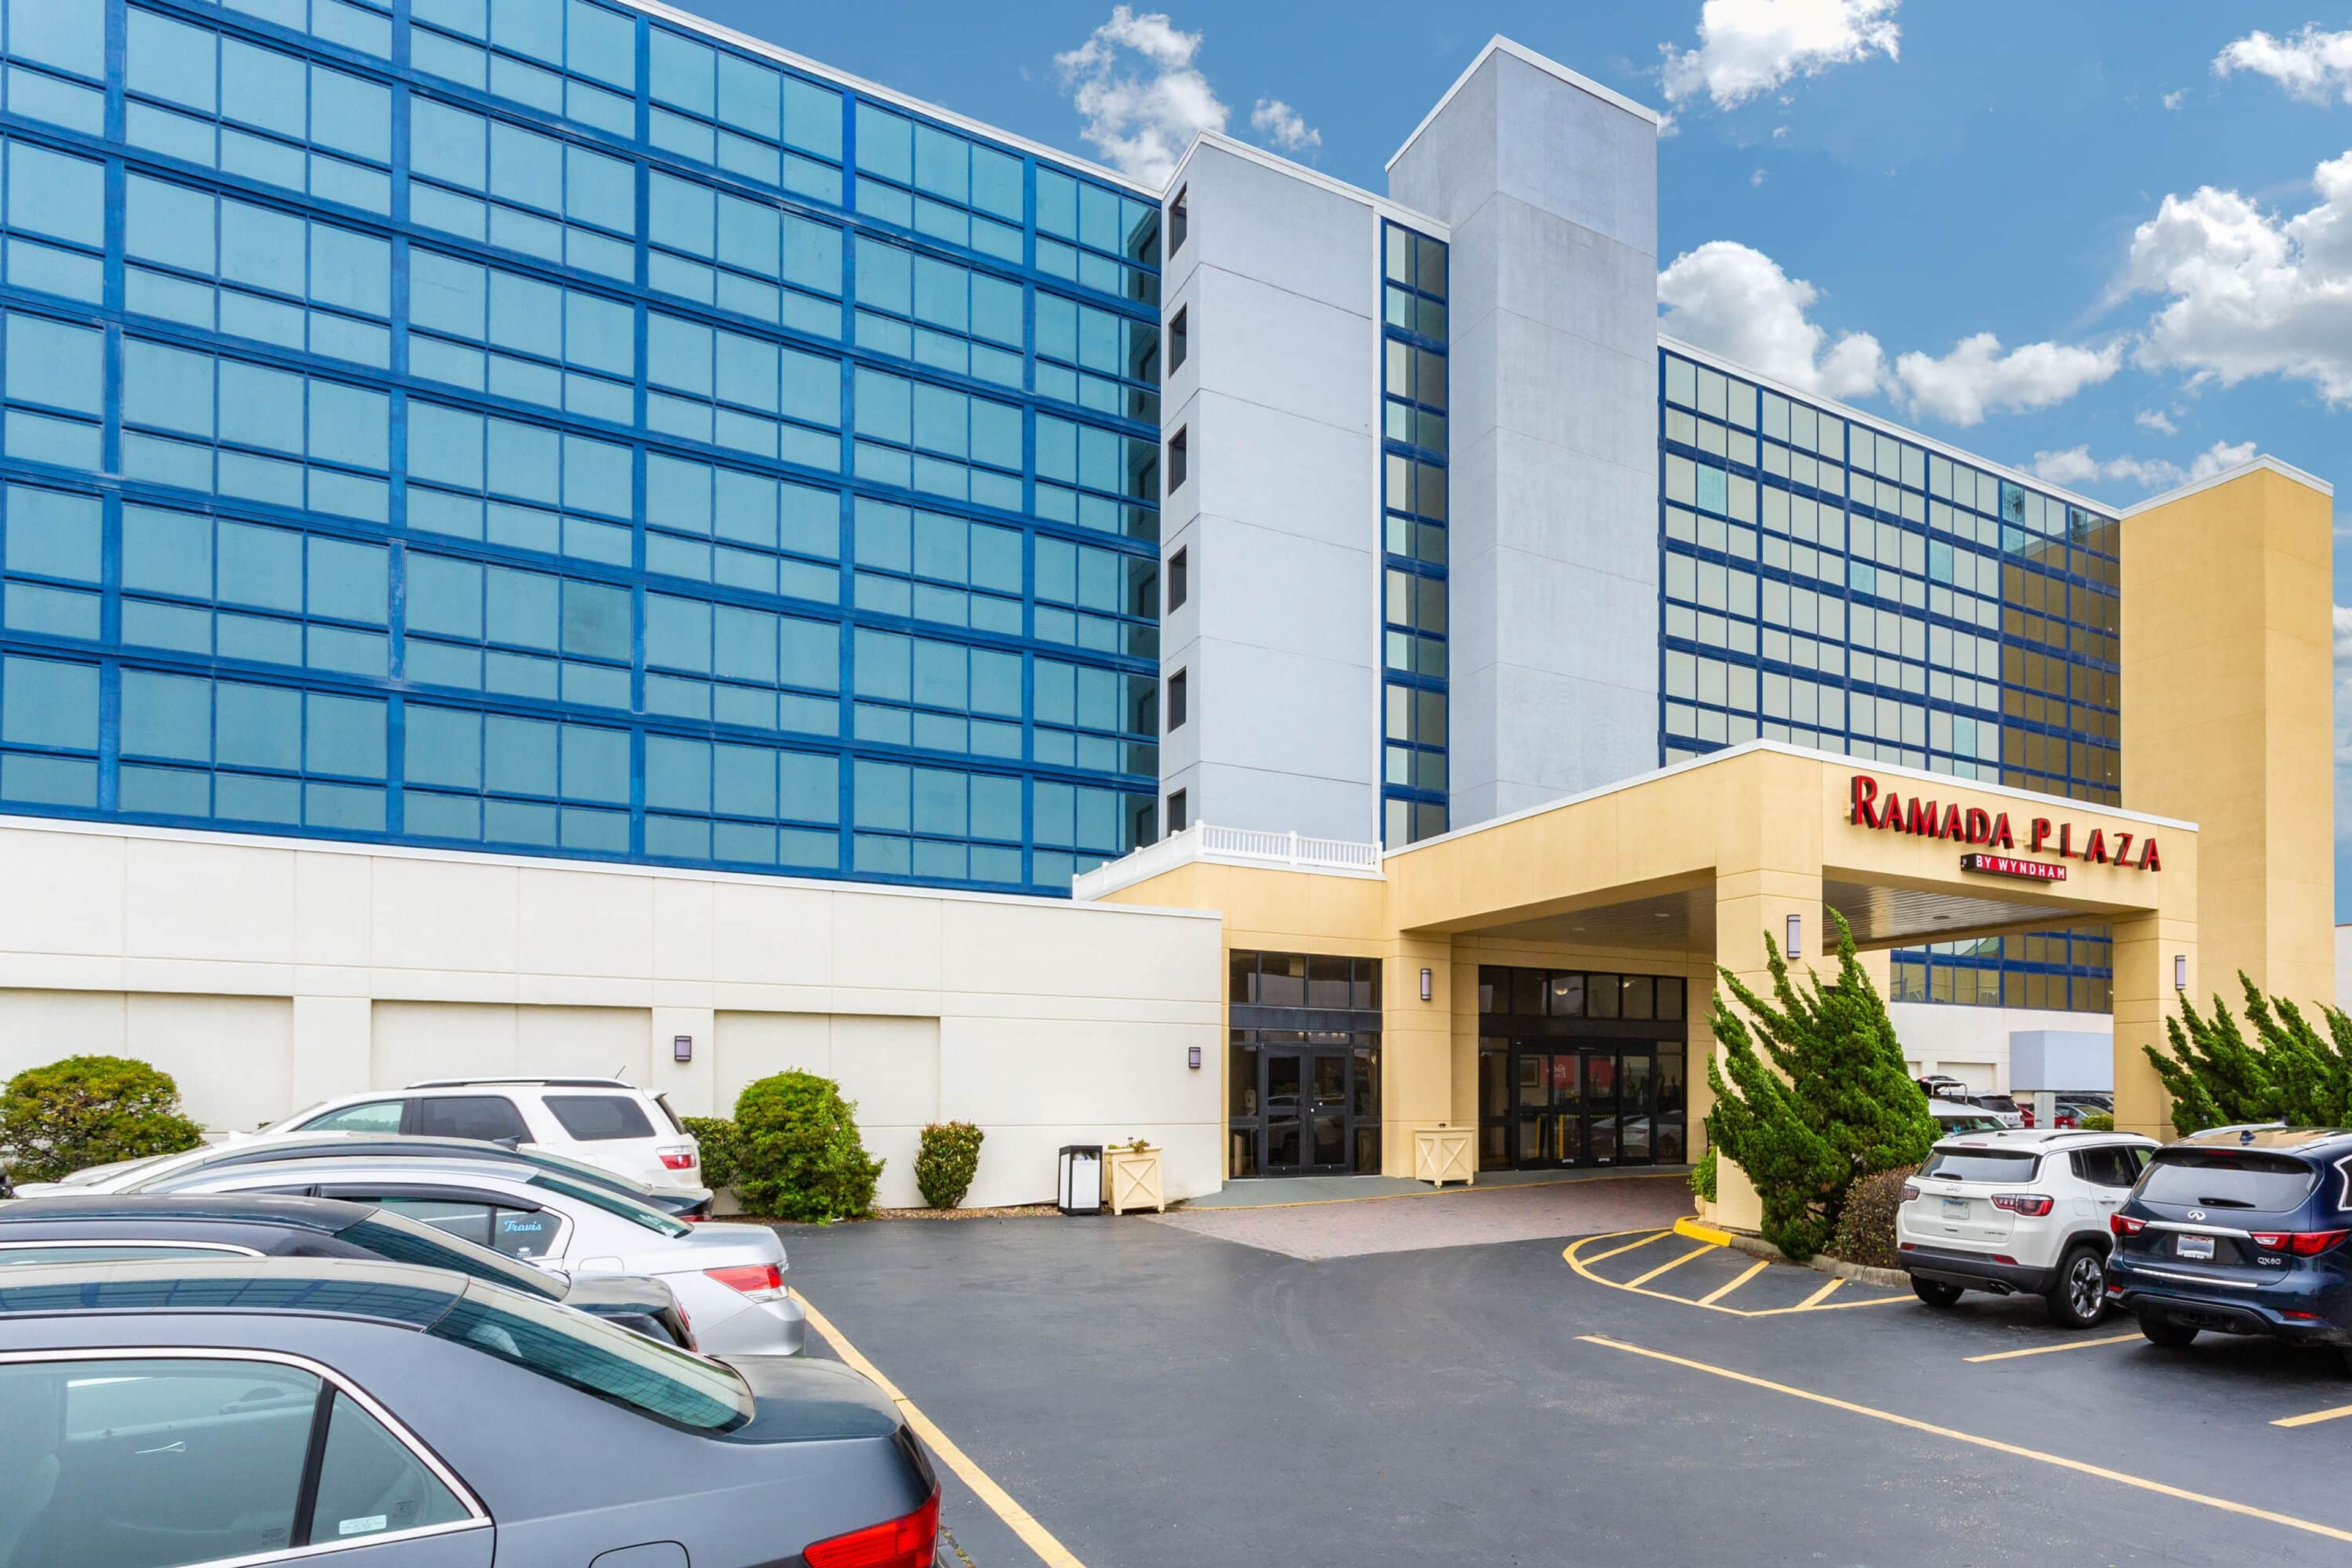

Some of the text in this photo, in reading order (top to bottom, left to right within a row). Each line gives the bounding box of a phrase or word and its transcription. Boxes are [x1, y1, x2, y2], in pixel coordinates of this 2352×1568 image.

[1851, 775, 2162, 872] RAMADA PLAZA
[1976, 855, 2065, 879] BY WYNDHAM
[504, 1220, 541, 1232] Travis
